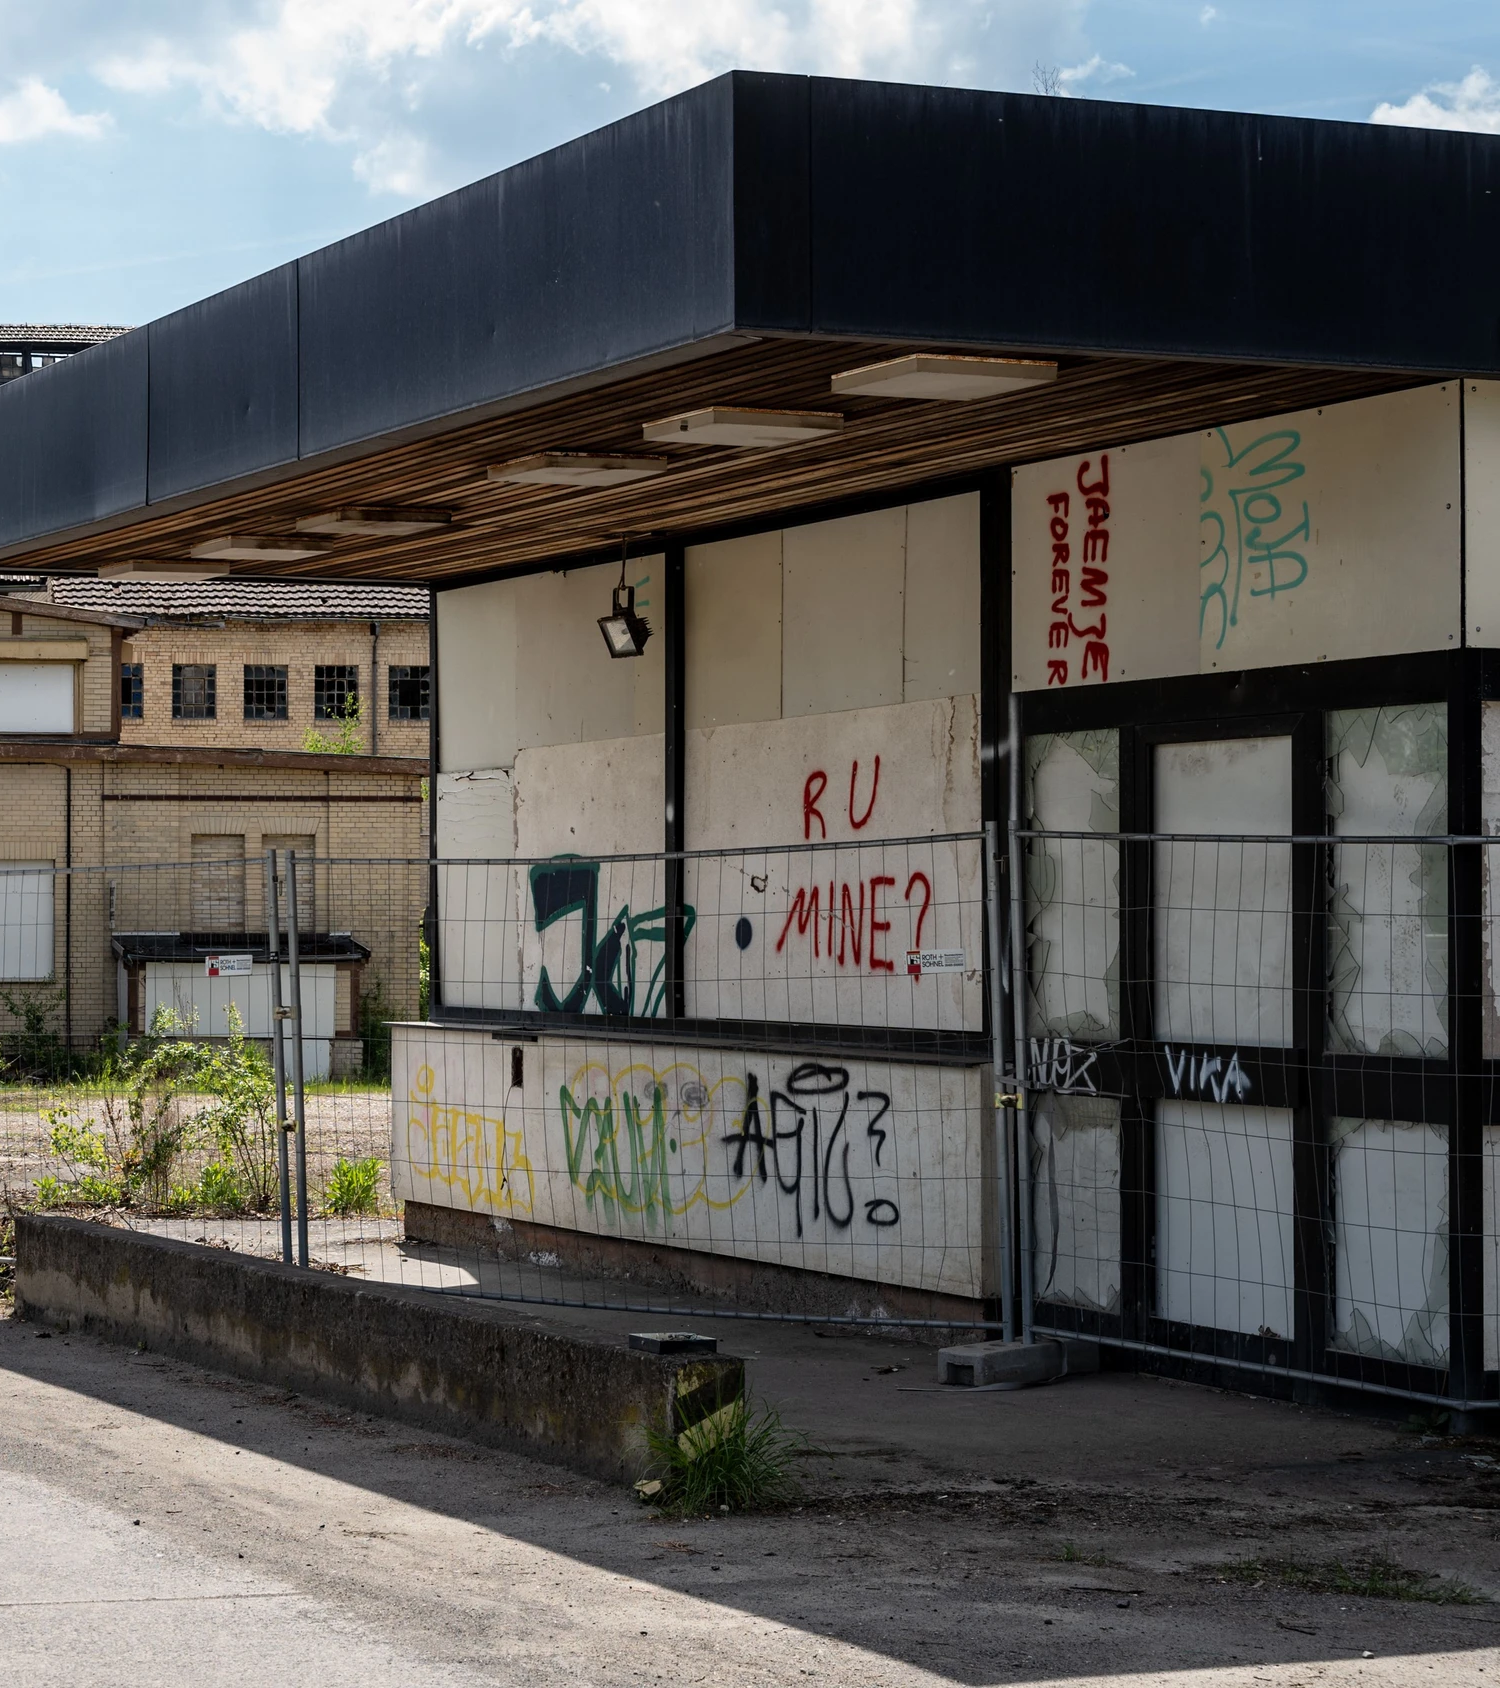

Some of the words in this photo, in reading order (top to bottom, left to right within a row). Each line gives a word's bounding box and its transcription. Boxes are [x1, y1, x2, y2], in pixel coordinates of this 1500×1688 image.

[1046, 492, 1070, 686] FOREVER
[803, 770, 828, 840] R
[848, 755, 880, 830] U
[775, 871, 932, 985] MINE?
